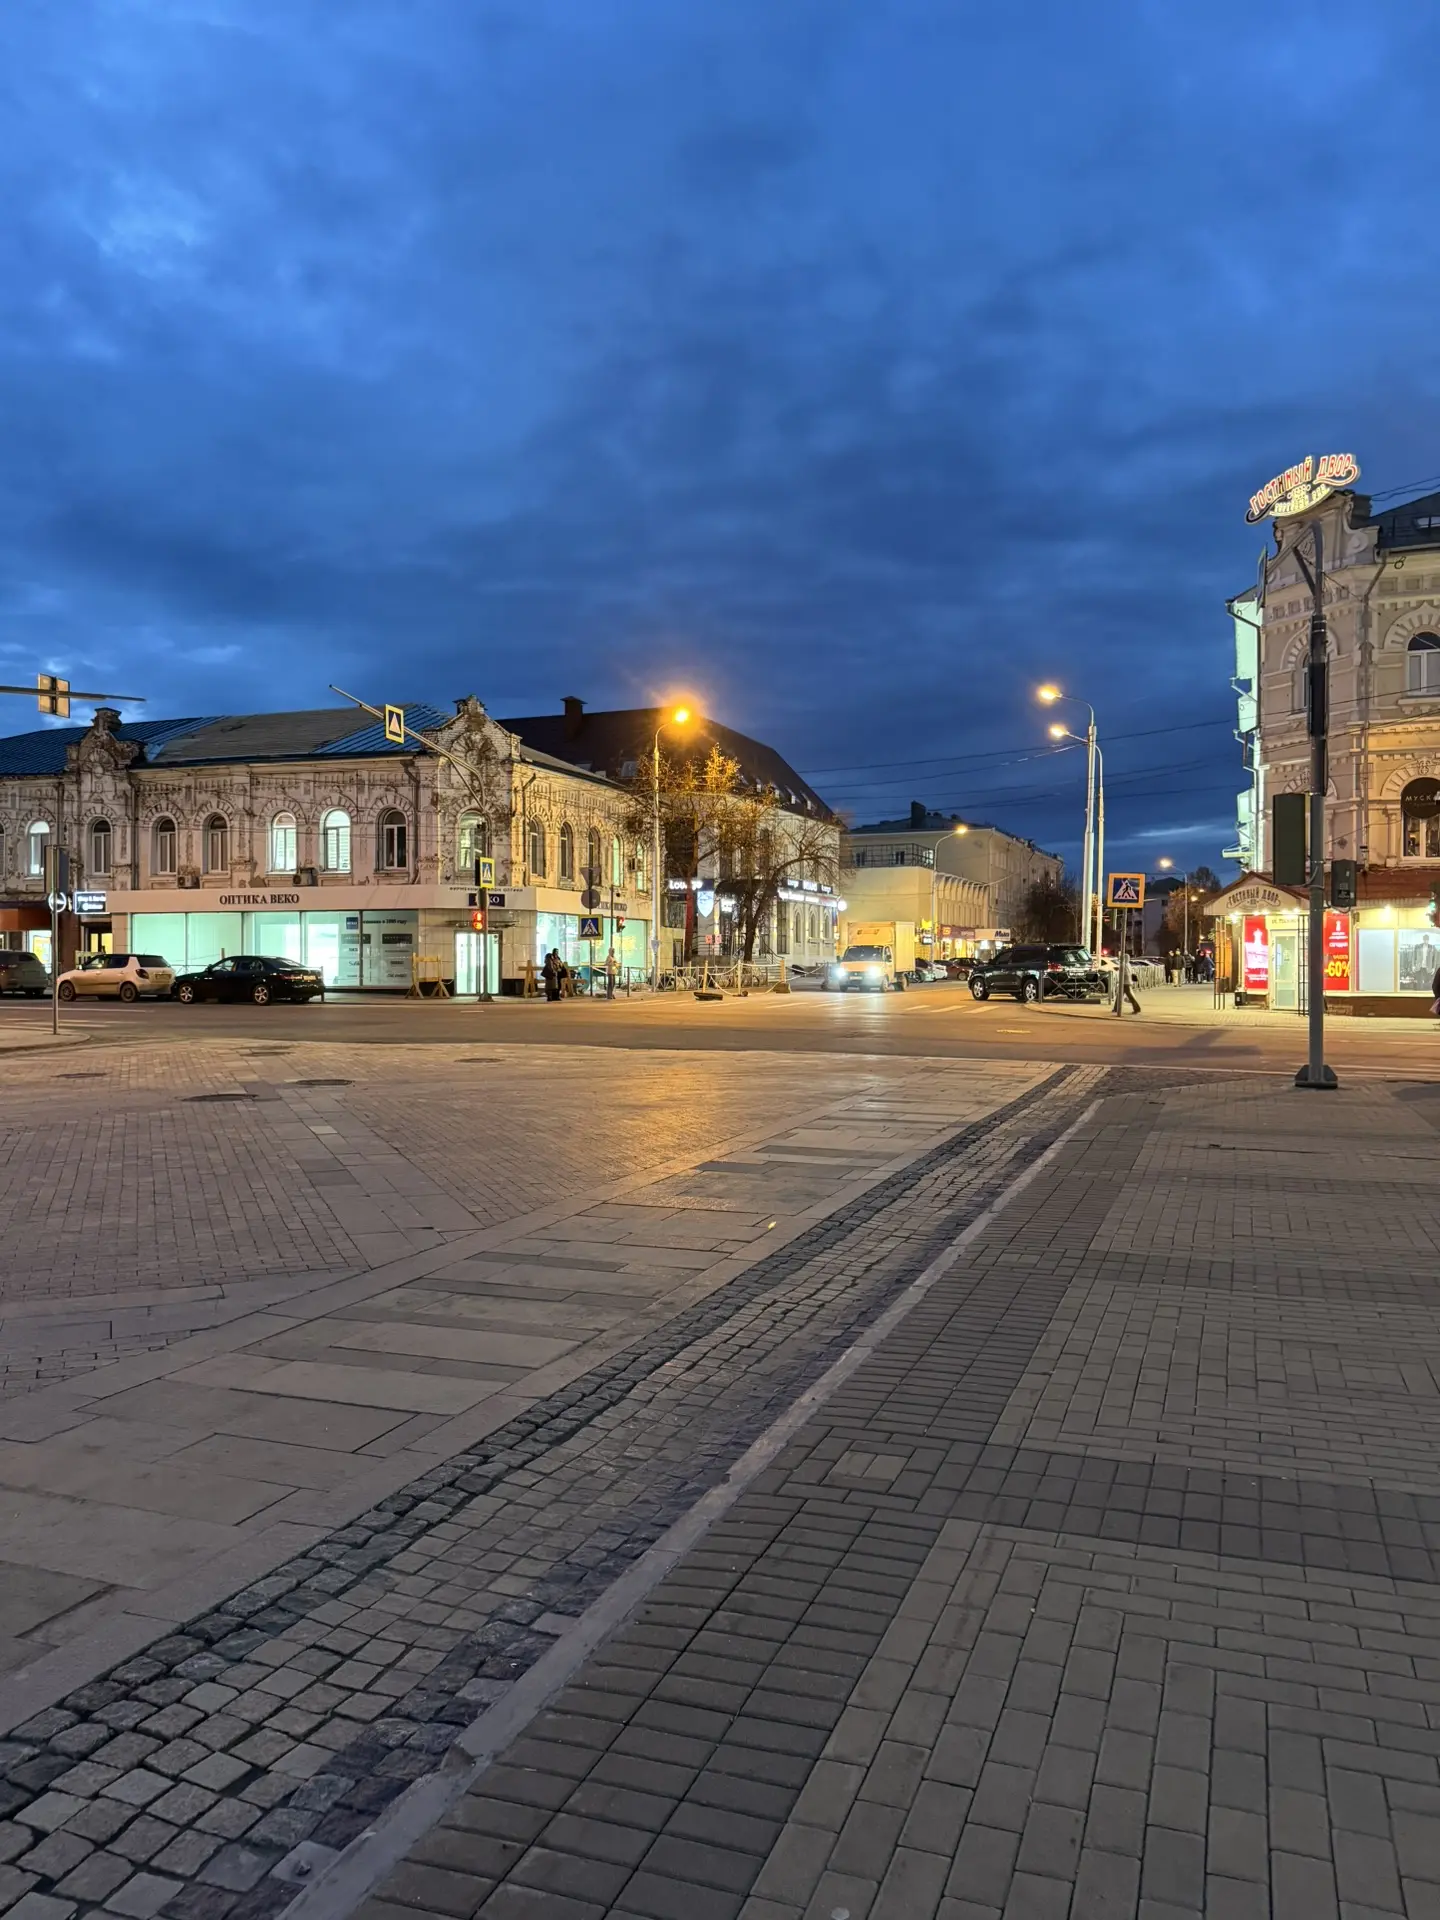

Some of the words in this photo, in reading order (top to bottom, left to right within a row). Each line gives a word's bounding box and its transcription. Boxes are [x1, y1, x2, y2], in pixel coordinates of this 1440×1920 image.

[1314, 453, 1355, 483] ДВОР
[219, 894, 267, 905] ОПТИКА
[270, 893, 299, 904] ВЕКО
[1261, 889, 1279, 904] ДВОР
[1325, 960, 1350, 978] -60%
